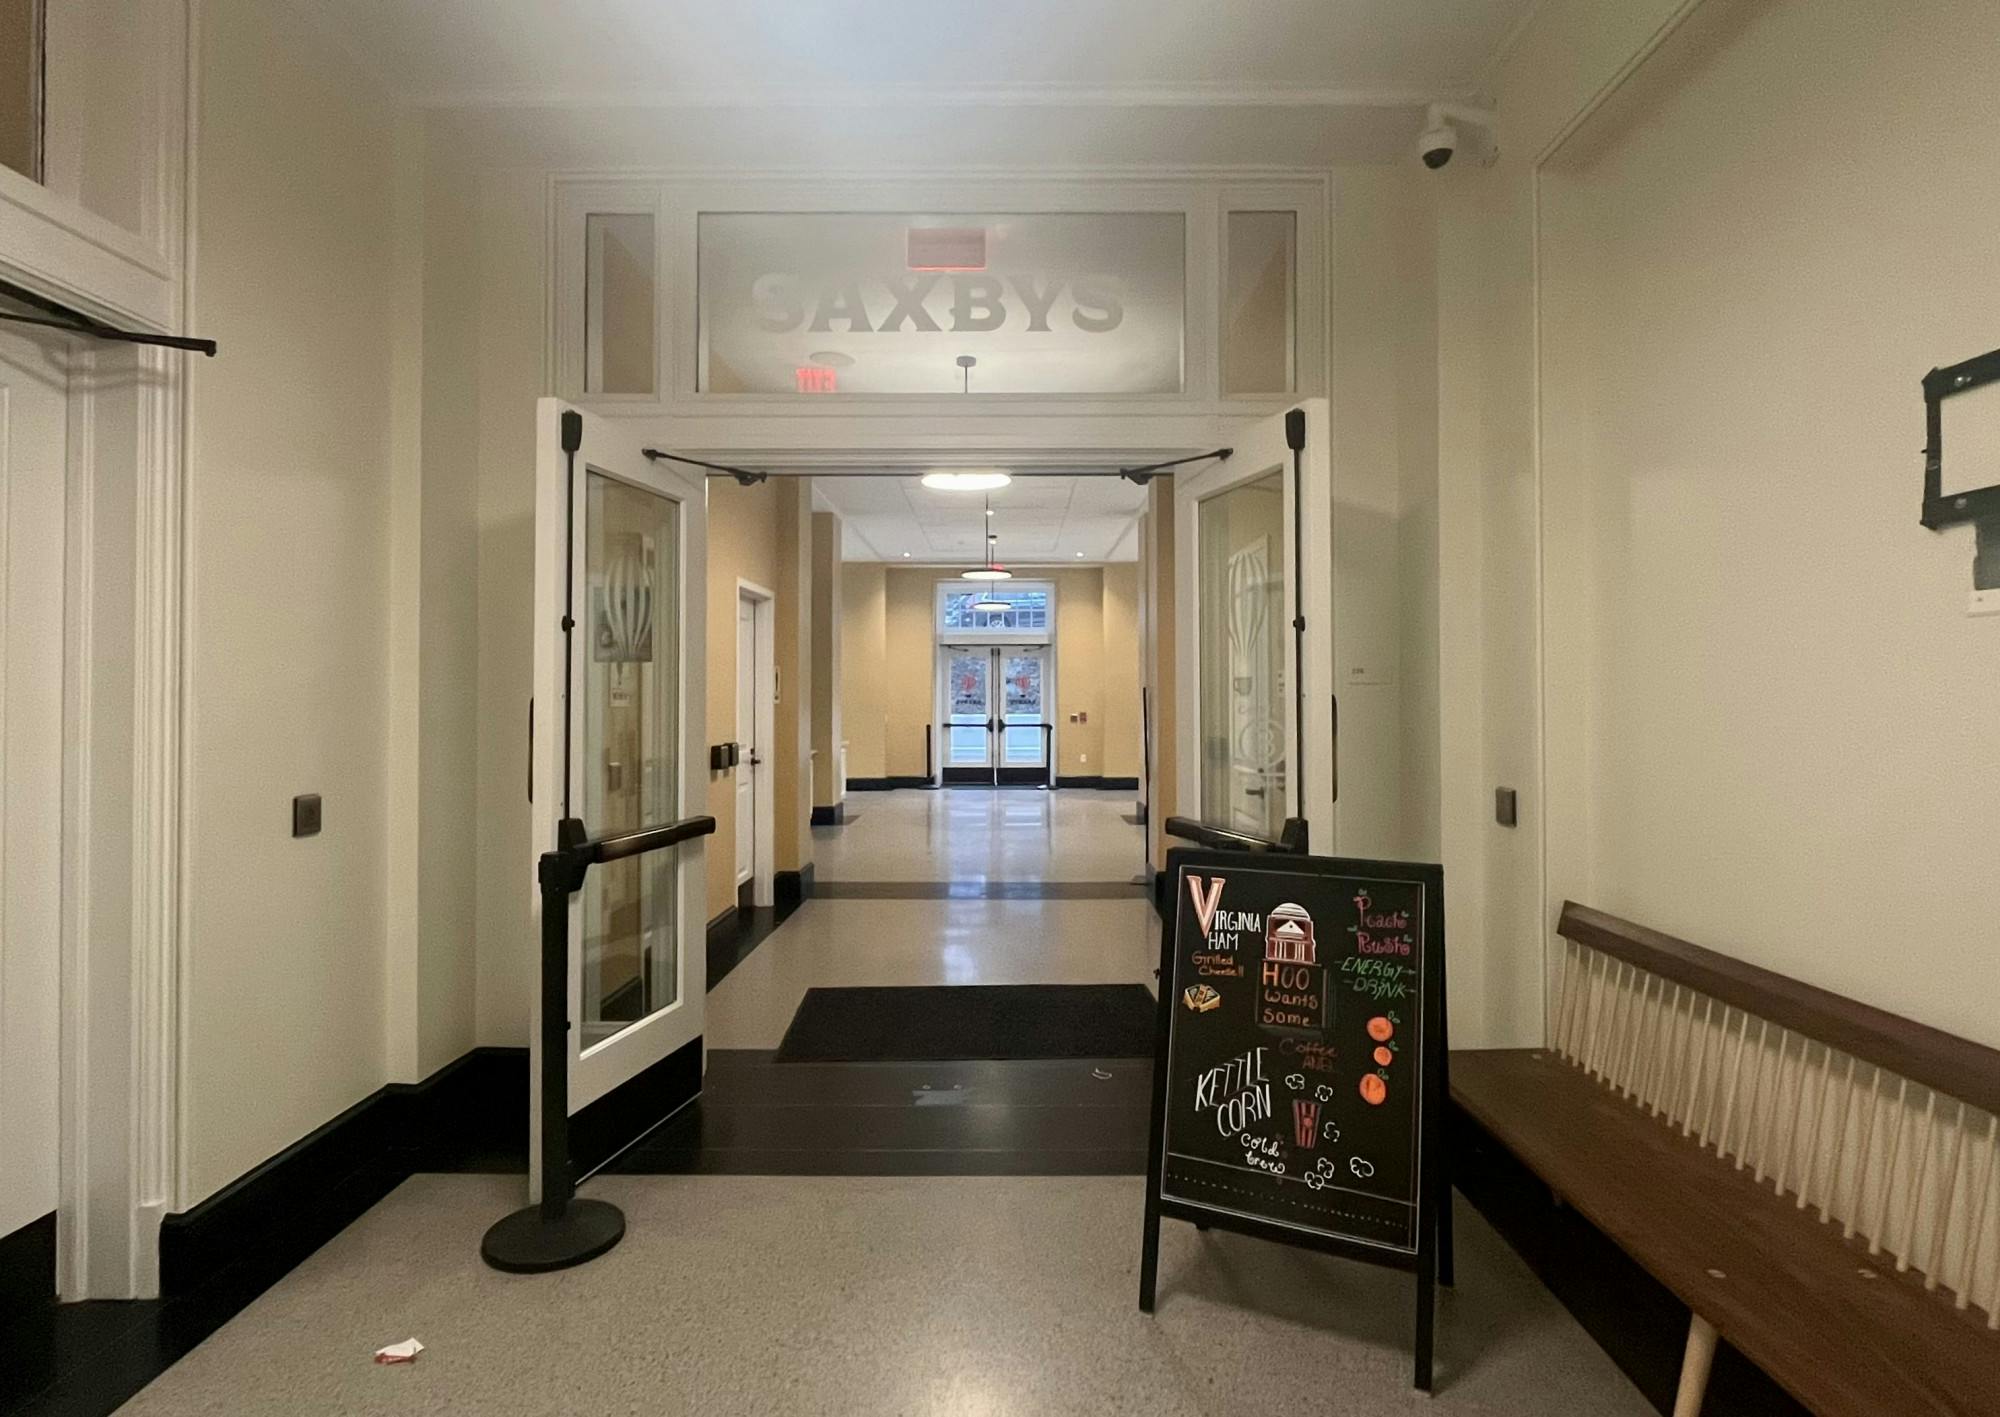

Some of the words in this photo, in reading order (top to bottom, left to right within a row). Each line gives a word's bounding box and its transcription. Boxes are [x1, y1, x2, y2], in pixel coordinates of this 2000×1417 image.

[752, 272, 1124, 333] SAXBYS
[1186, 875, 1261, 939] VIRGINIA
[1191, 950, 1234, 966] Grilled
[1208, 932, 1239, 950] HAM
[1341, 957, 1403, 980] ENERGY
[1195, 1047, 1269, 1112] KETTLE
[1217, 1083, 1271, 1138] CORN
